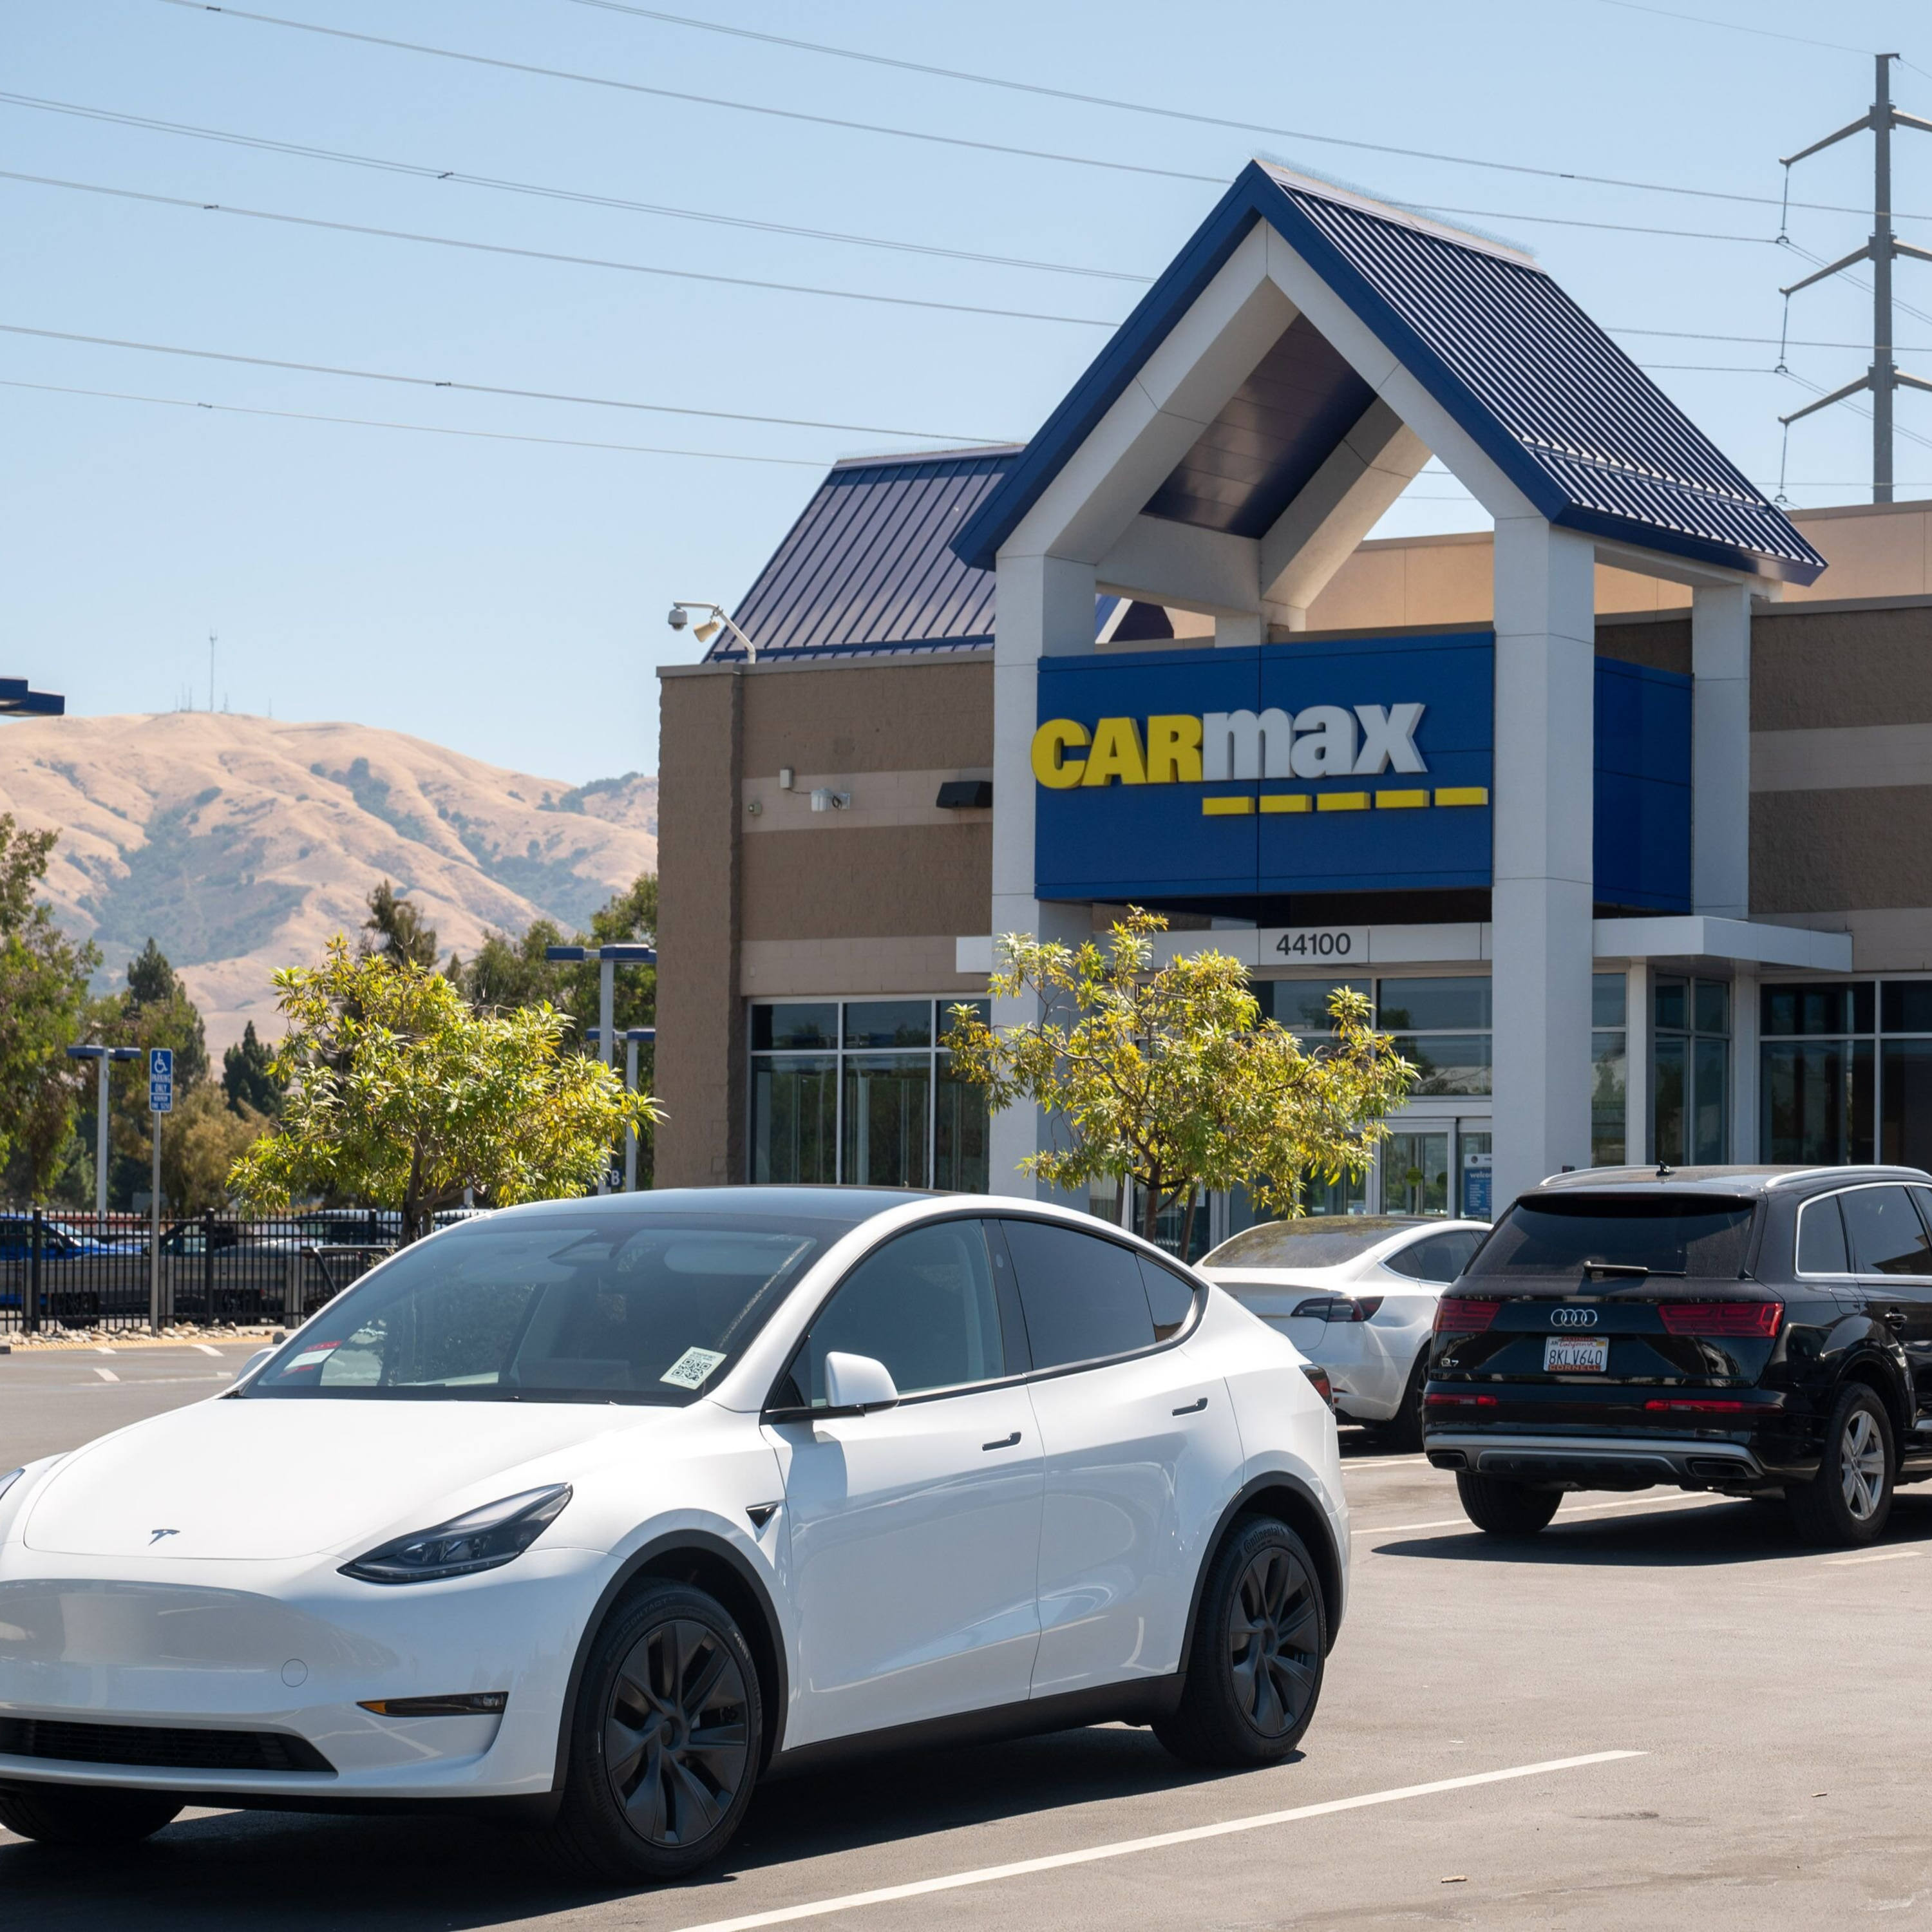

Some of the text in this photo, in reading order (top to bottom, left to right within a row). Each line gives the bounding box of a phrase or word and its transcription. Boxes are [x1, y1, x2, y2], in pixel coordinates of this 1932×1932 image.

[1276, 933, 1351, 956] 44100
[151, 1074, 171, 1083] PARKING
[155, 1083, 167, 1093] ONLY
[611, 1170, 620, 1186] B
[1549, 1350, 1602, 1365] 8KLV640
[1244, 1526, 1280, 1554] Continental
